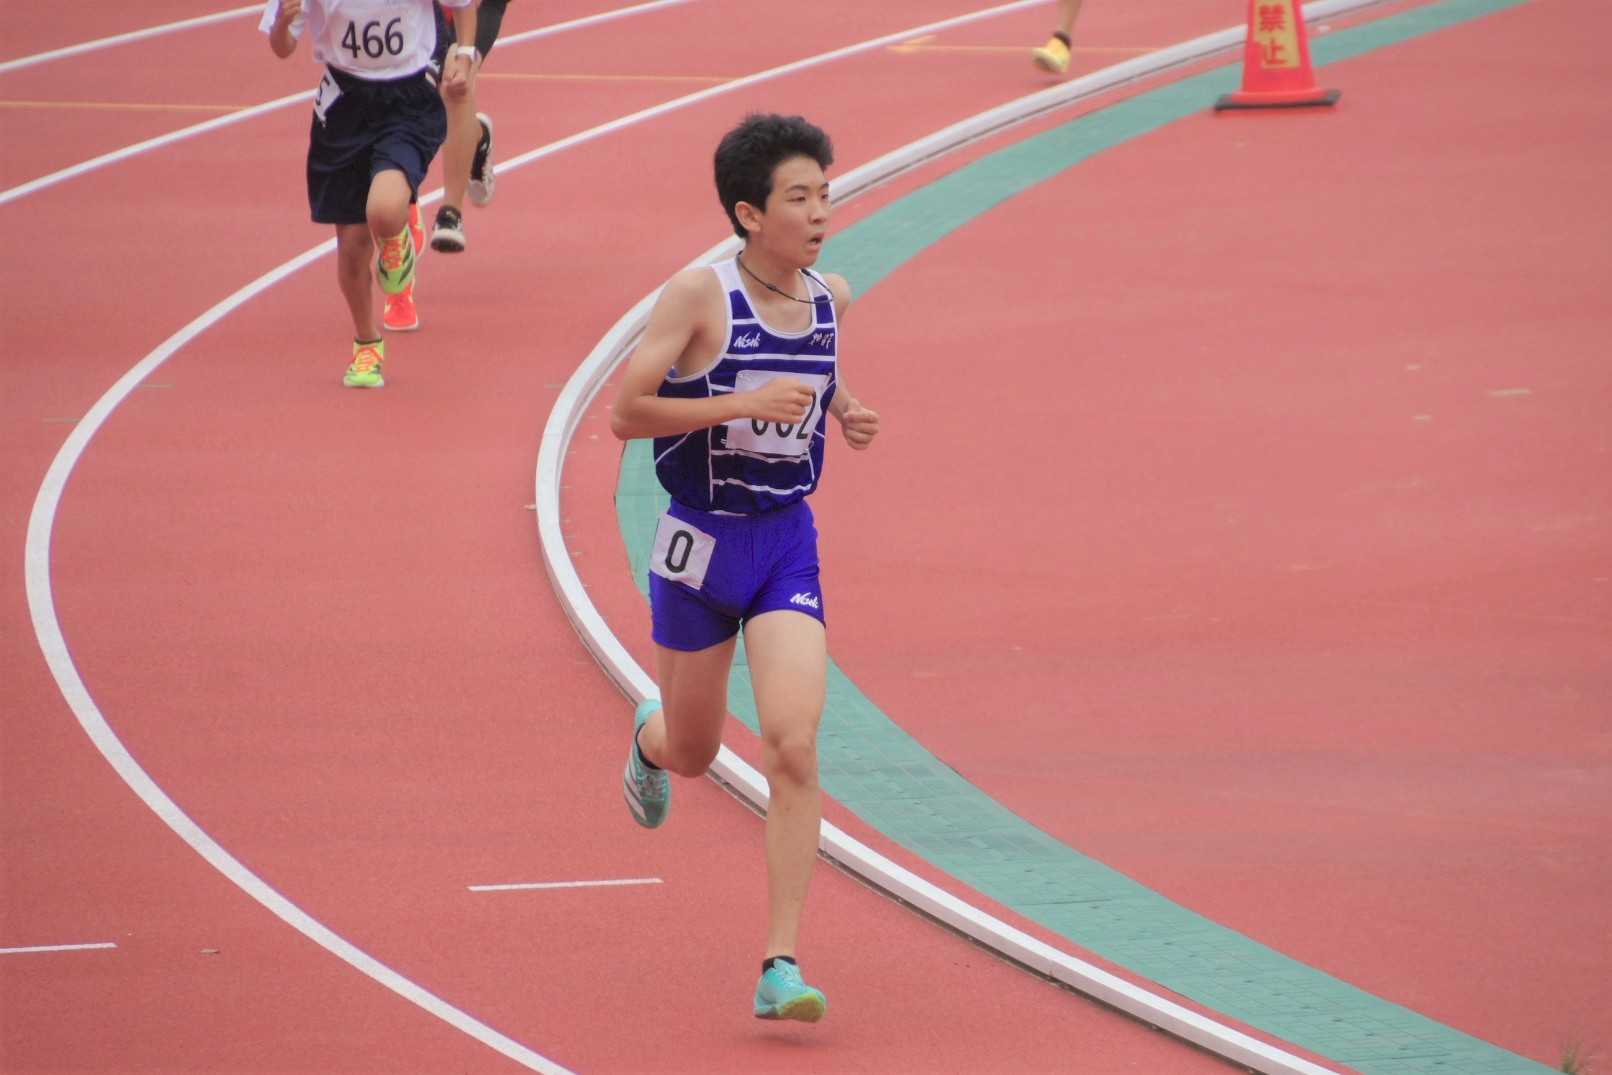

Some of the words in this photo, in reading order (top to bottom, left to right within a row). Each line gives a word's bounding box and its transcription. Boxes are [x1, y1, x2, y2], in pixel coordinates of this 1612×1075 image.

[341, 17, 404, 59] 466
[1259, 4, 1288, 65] 禁止
[665, 530, 694, 573] 0
